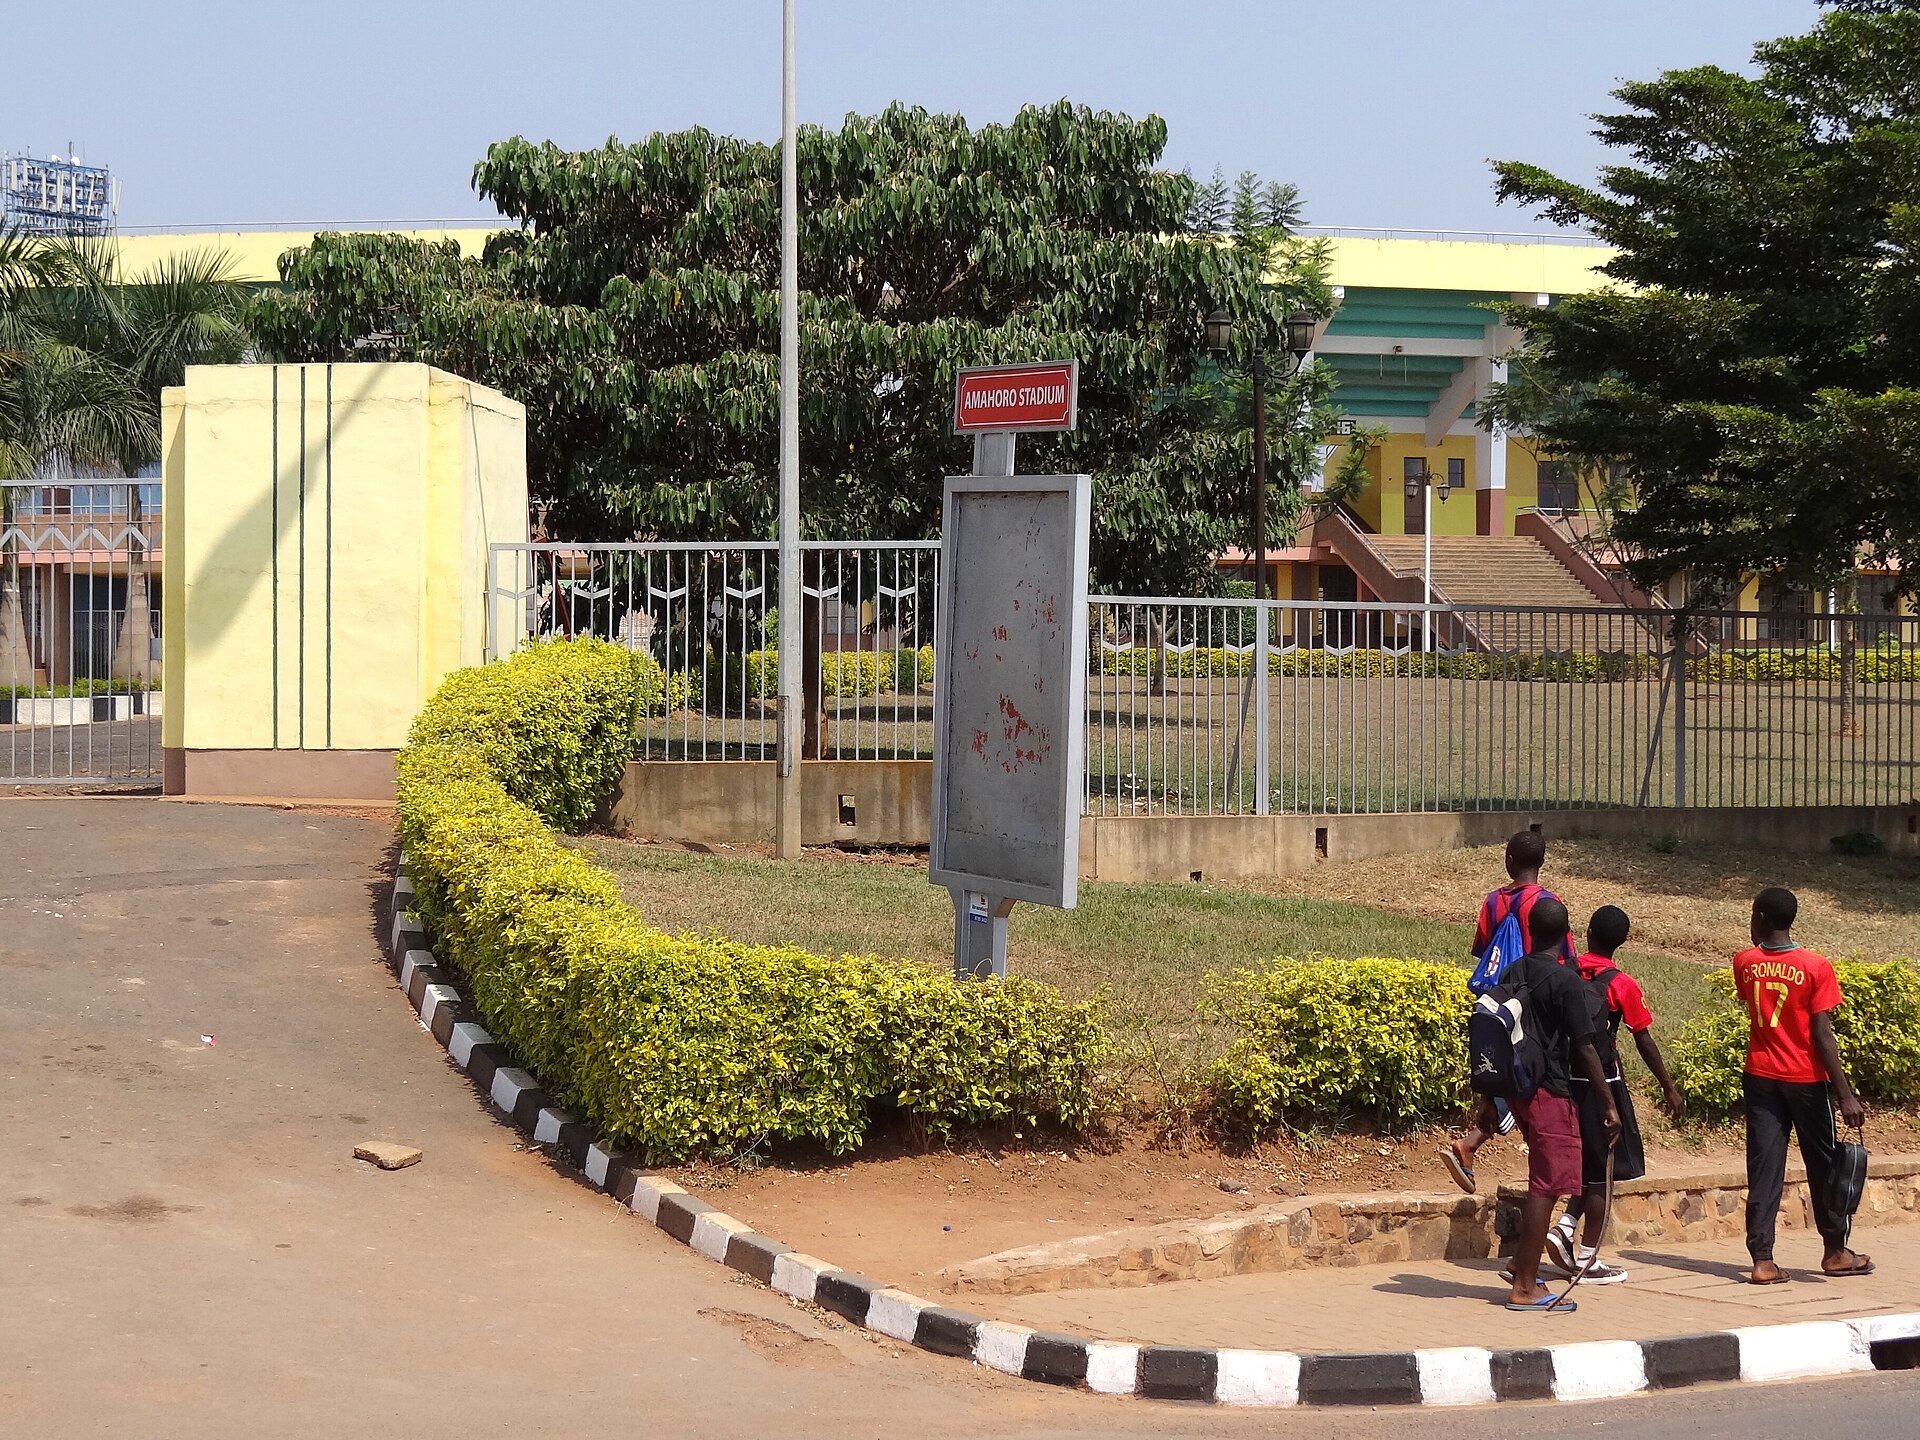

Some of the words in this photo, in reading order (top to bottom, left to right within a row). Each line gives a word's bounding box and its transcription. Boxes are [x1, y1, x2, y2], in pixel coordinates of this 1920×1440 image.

[964, 388, 1017, 410] AMAHORO
[1018, 384, 1065, 407] STADIUM
[1743, 961, 1805, 985] C.RONALDO
[1753, 980, 1789, 1028] 17
